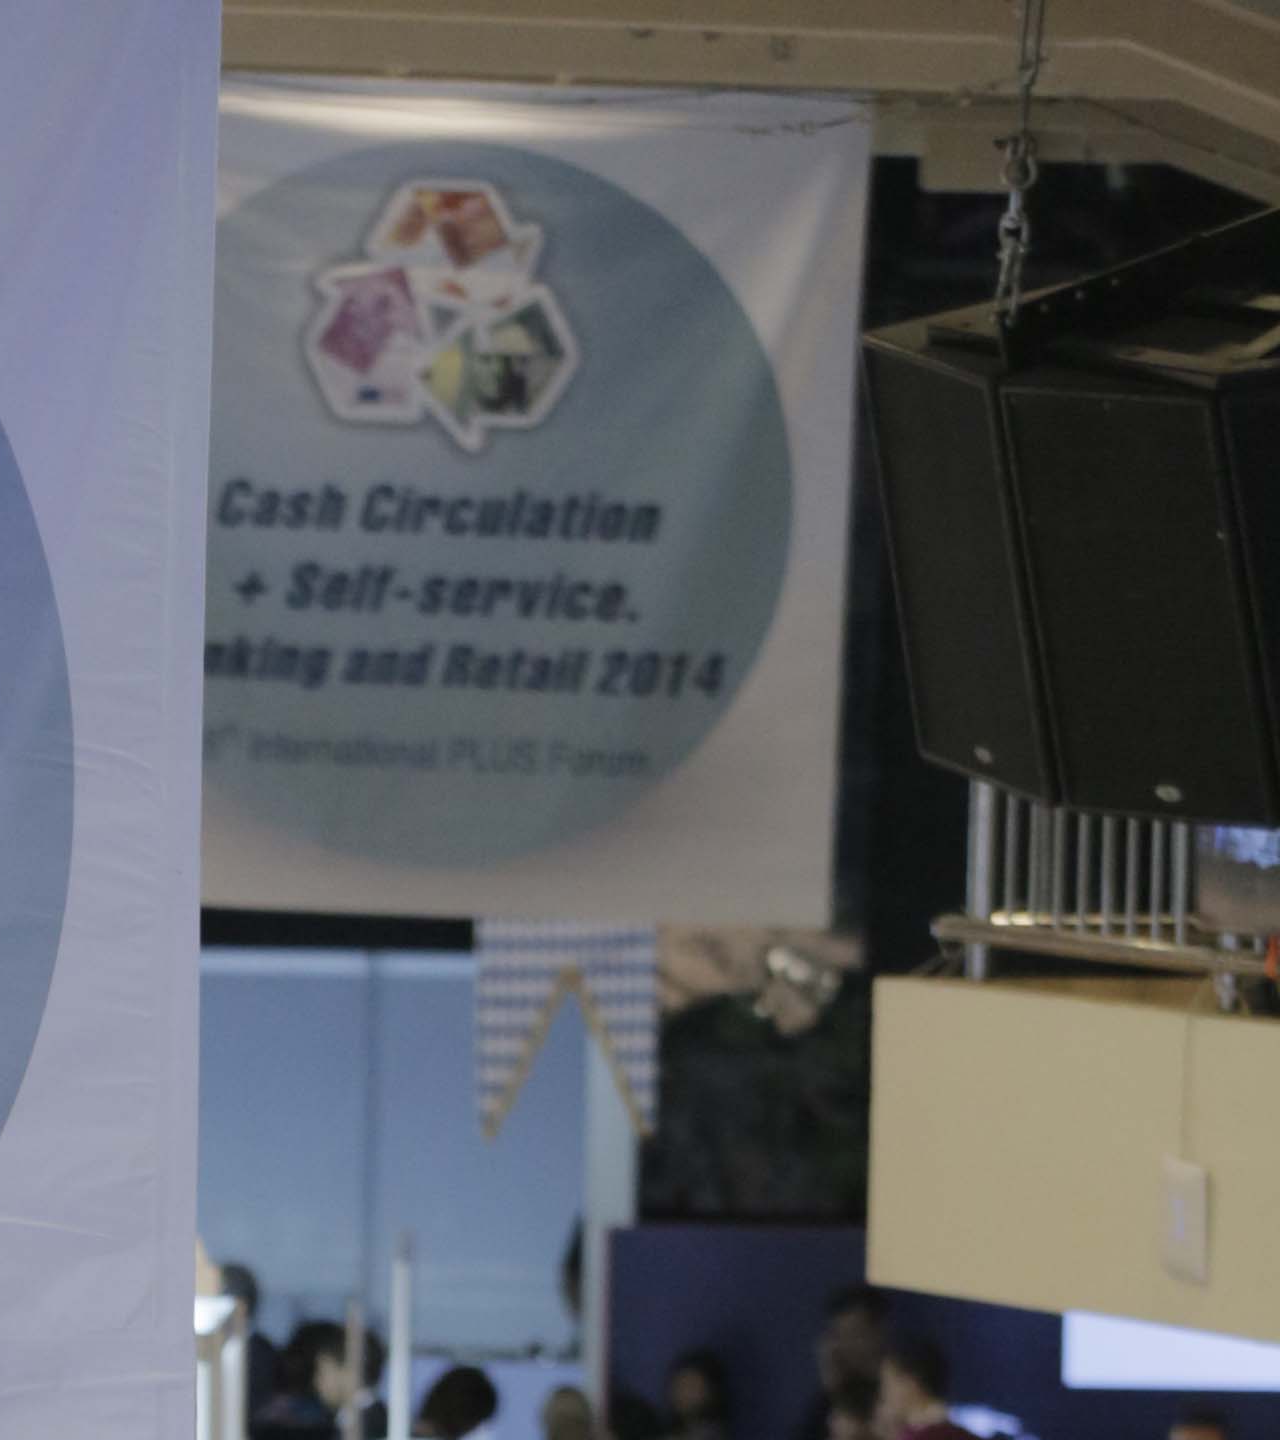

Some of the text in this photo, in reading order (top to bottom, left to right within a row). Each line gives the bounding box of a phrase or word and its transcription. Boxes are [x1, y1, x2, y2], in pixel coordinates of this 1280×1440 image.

[217, 480, 662, 544] Cash Circulation
[345, 643, 436, 687] and
[443, 643, 592, 694] Retail
[595, 649, 727, 698] 2014
